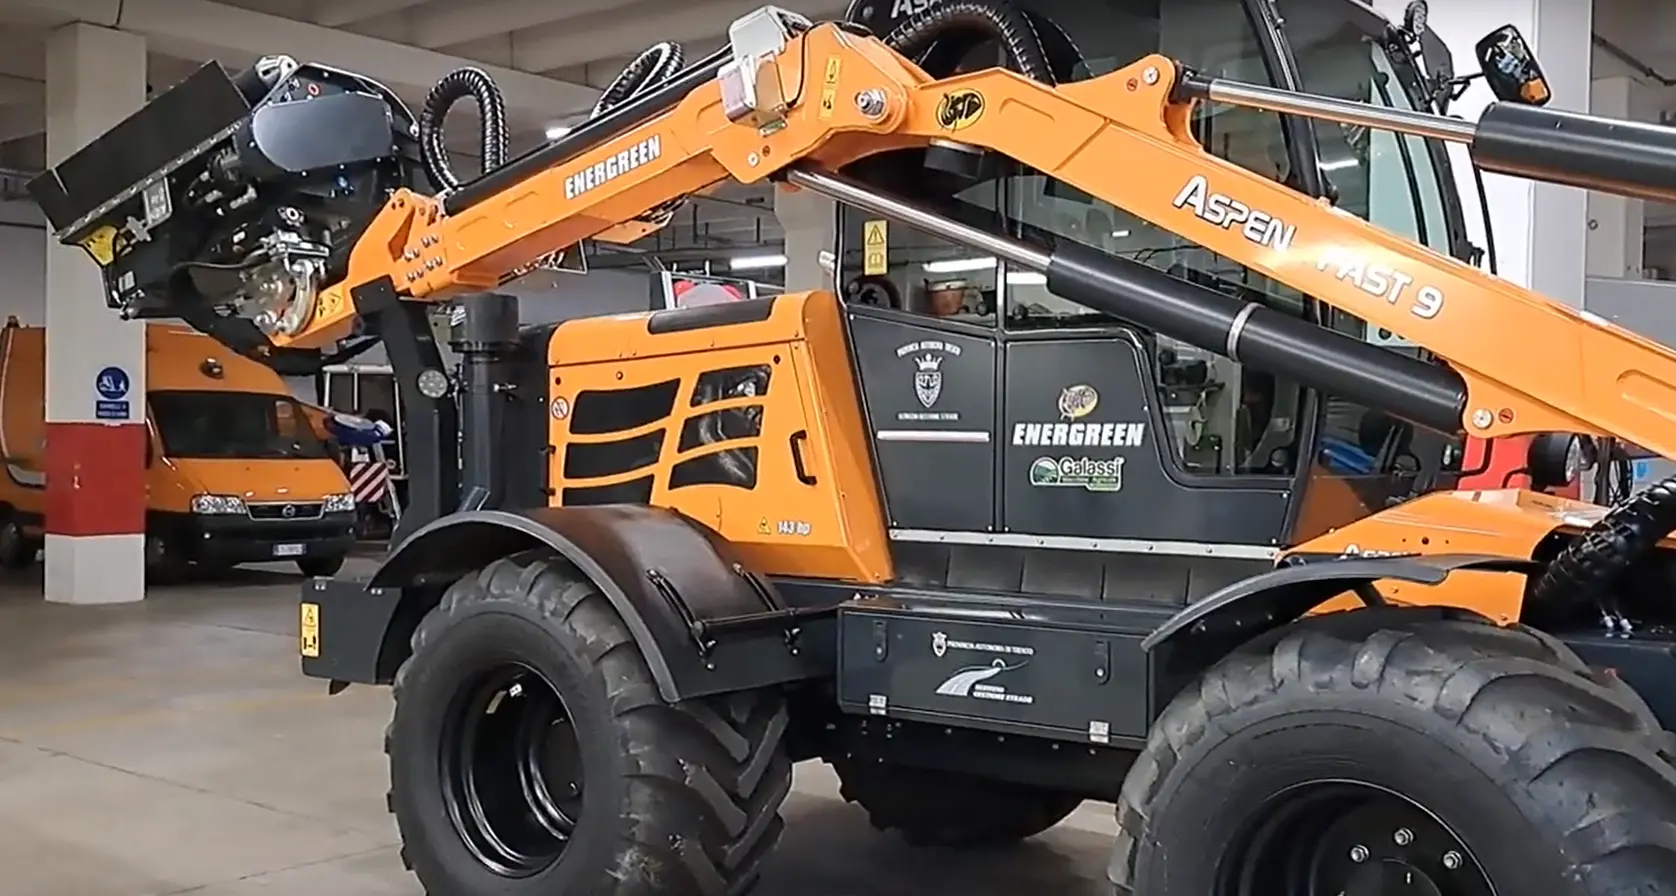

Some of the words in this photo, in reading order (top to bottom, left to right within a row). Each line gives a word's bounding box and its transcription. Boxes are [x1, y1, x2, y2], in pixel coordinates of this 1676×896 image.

[565, 134, 660, 200] ENERGREEN
[1172, 175, 1296, 251] ASPEN
[1411, 286, 1444, 319] 9
[1012, 422, 1145, 447] ENERGREEN
[1060, 458, 1121, 477] Galassi
